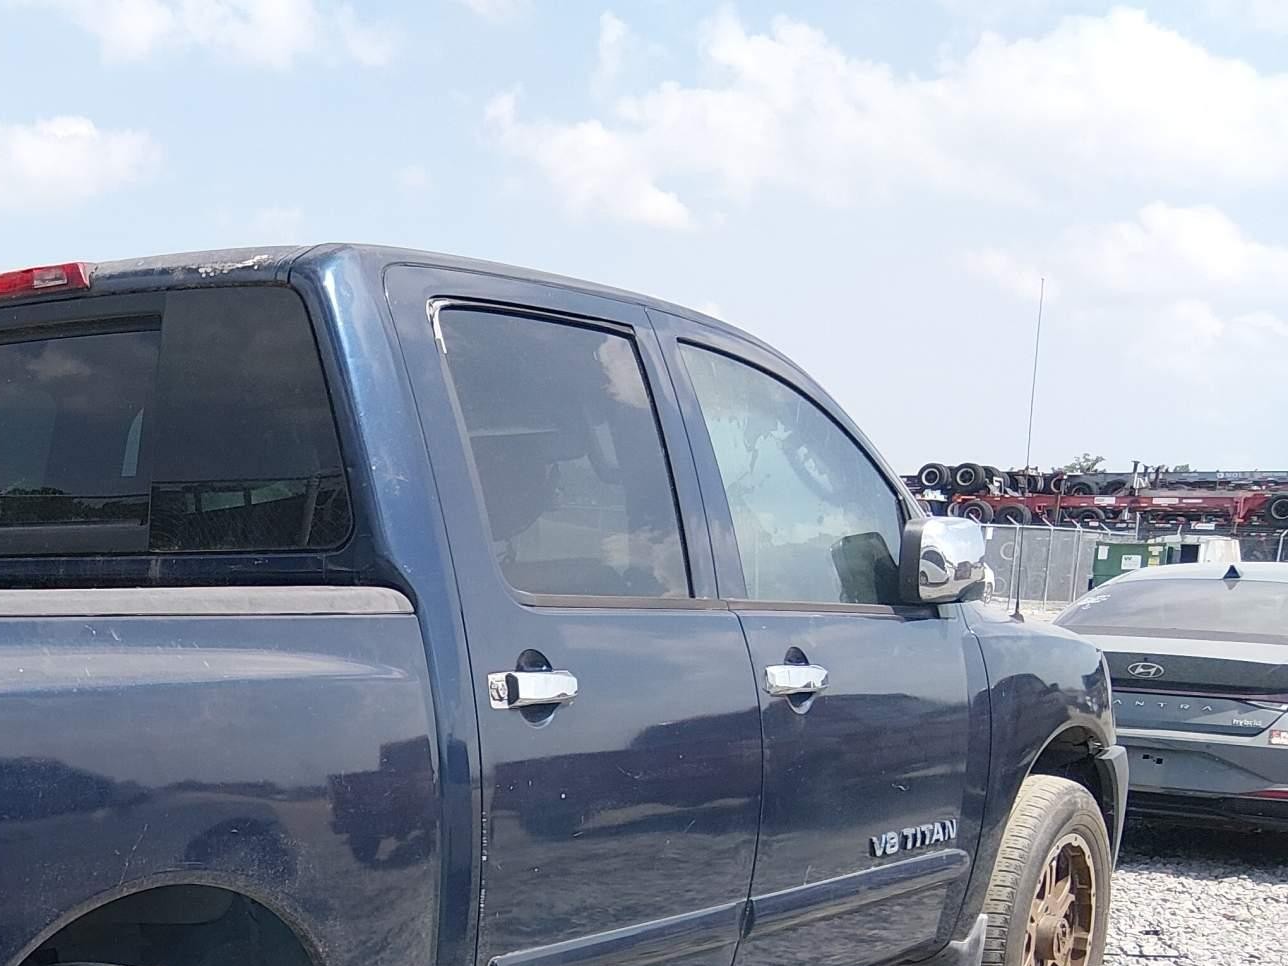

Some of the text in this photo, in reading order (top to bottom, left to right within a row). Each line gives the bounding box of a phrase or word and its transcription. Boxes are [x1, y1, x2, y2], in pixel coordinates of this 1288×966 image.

[1112, 699, 1213, 712] ANTRA
[871, 818, 957, 857] V8 TITAN
